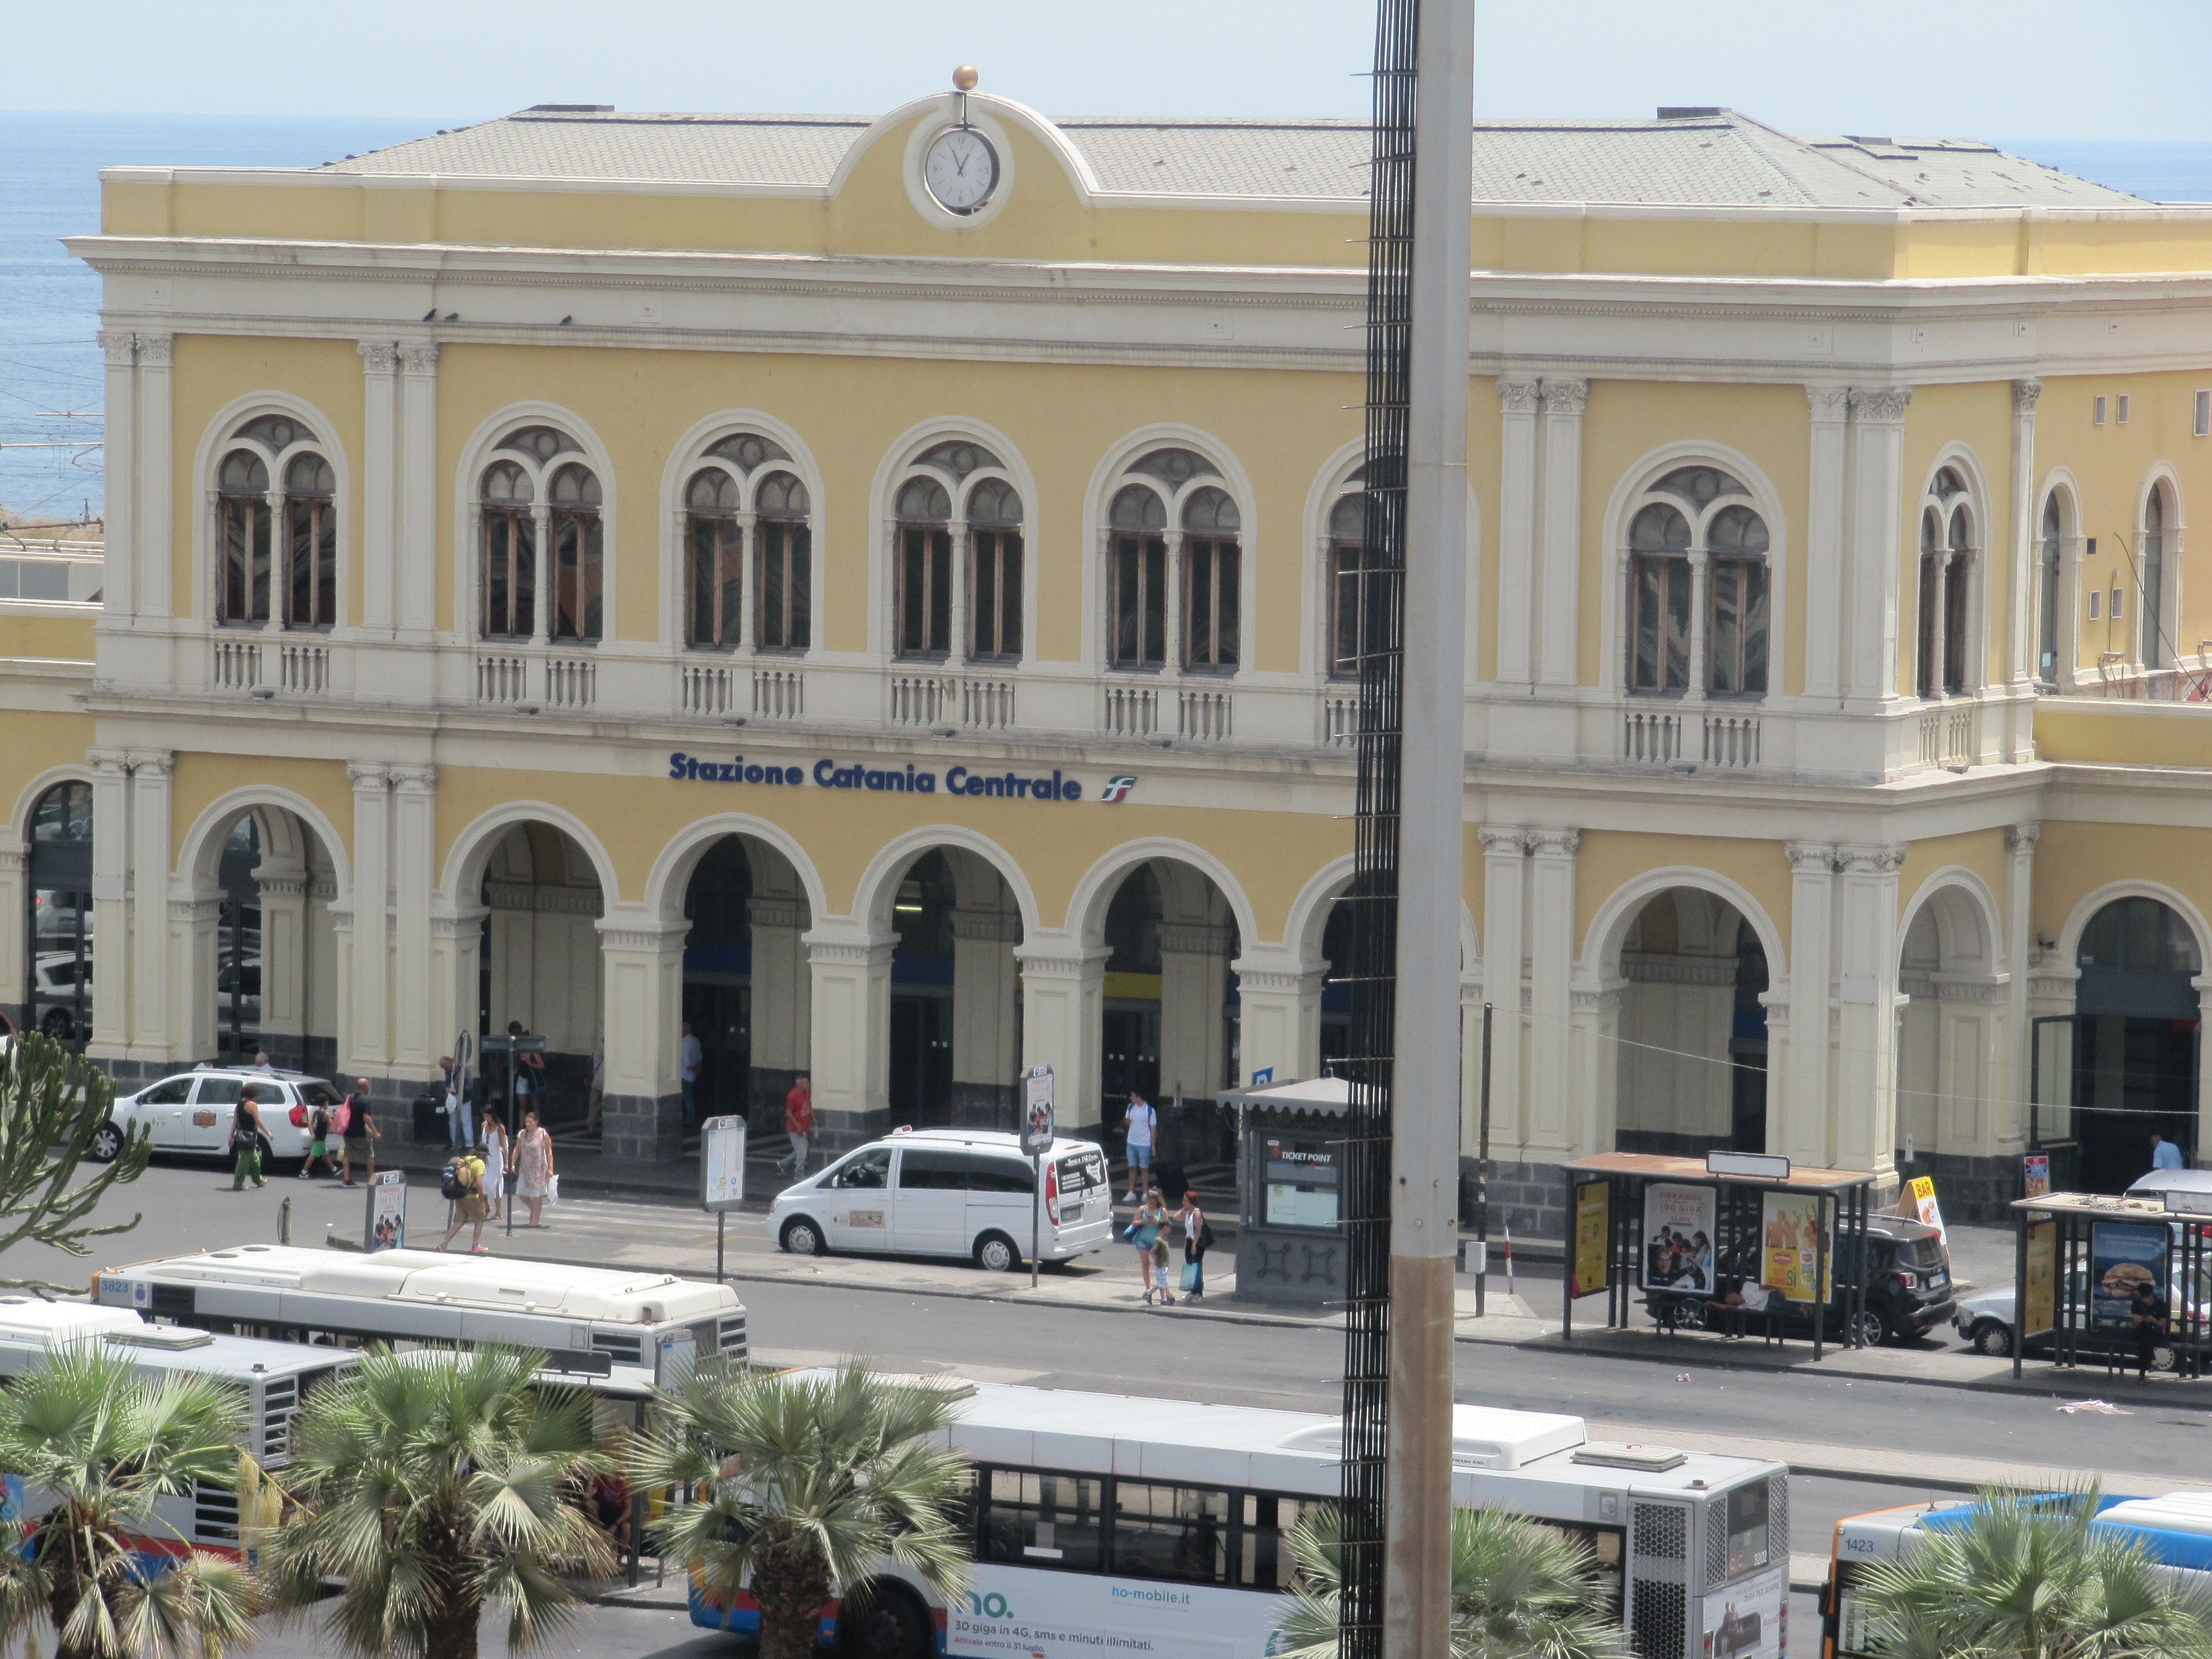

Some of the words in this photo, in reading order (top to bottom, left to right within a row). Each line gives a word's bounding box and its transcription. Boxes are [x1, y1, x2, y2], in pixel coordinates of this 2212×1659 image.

[669, 752, 804, 785] Stazione
[813, 758, 935, 792] Catania
[945, 766, 1082, 801] Centrale
[1282, 1152, 1307, 1161] TICKET
[1308, 1153, 1331, 1162] POINT
[1915, 1181, 1933, 1198] BAR
[102, 1281, 128, 1293] 3823
[1845, 1539, 1873, 1552] 1423
[1111, 1585, 1190, 1604] ho-mobile.it
[955, 1620, 969, 1631] 30
[972, 1623, 996, 1635] giga
[1000, 1625, 1009, 1635] in
[1013, 1627, 1031, 1639] 4G,
[1034, 1631, 1055, 1641] sms
[1059, 1633, 1066, 1641] e
[1069, 1633, 1103, 1646] minuti
[1107, 1635, 1153, 1650] illimitati.
[985, 1639, 1005, 1648] entro
[1023, 1643, 1046, 1653] luglio.
